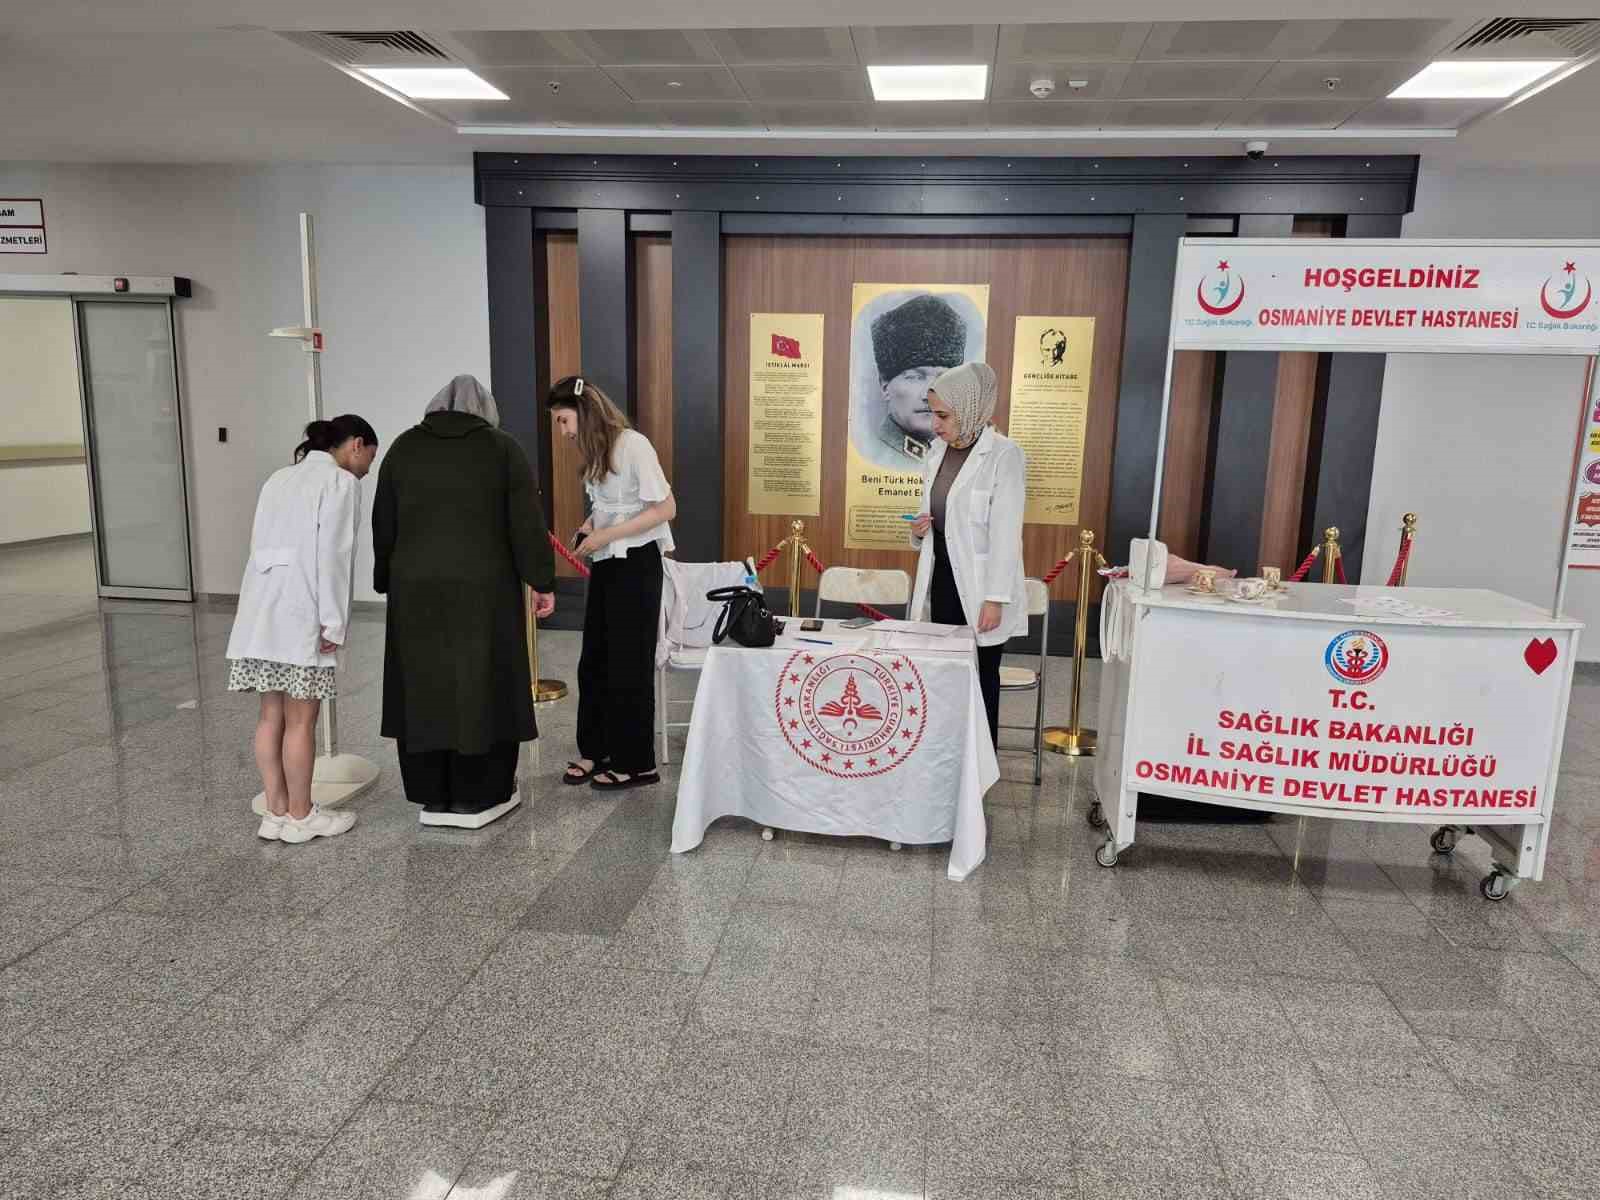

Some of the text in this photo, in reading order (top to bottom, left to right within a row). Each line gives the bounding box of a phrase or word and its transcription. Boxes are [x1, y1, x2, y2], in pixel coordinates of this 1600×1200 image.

[1303, 265, 1481, 292] HOŞGELDİNİZ
[1258, 305, 1519, 329] OSMANİYE DEVLET HASTANESİ
[861, 474, 882, 484] Beni
[884, 474, 905, 485] Türk
[878, 487, 912, 497] Emanet
[1328, 688, 1377, 712] T.C.
[1217, 709, 1475, 747] SAĞLIK BAKANLIĞI
[1185, 732, 1498, 778] İL SAĞLIK MÜDÜRLÜĞÜ
[1135, 759, 1538, 809] OSMANİYE DEVLET HASTANESİ
